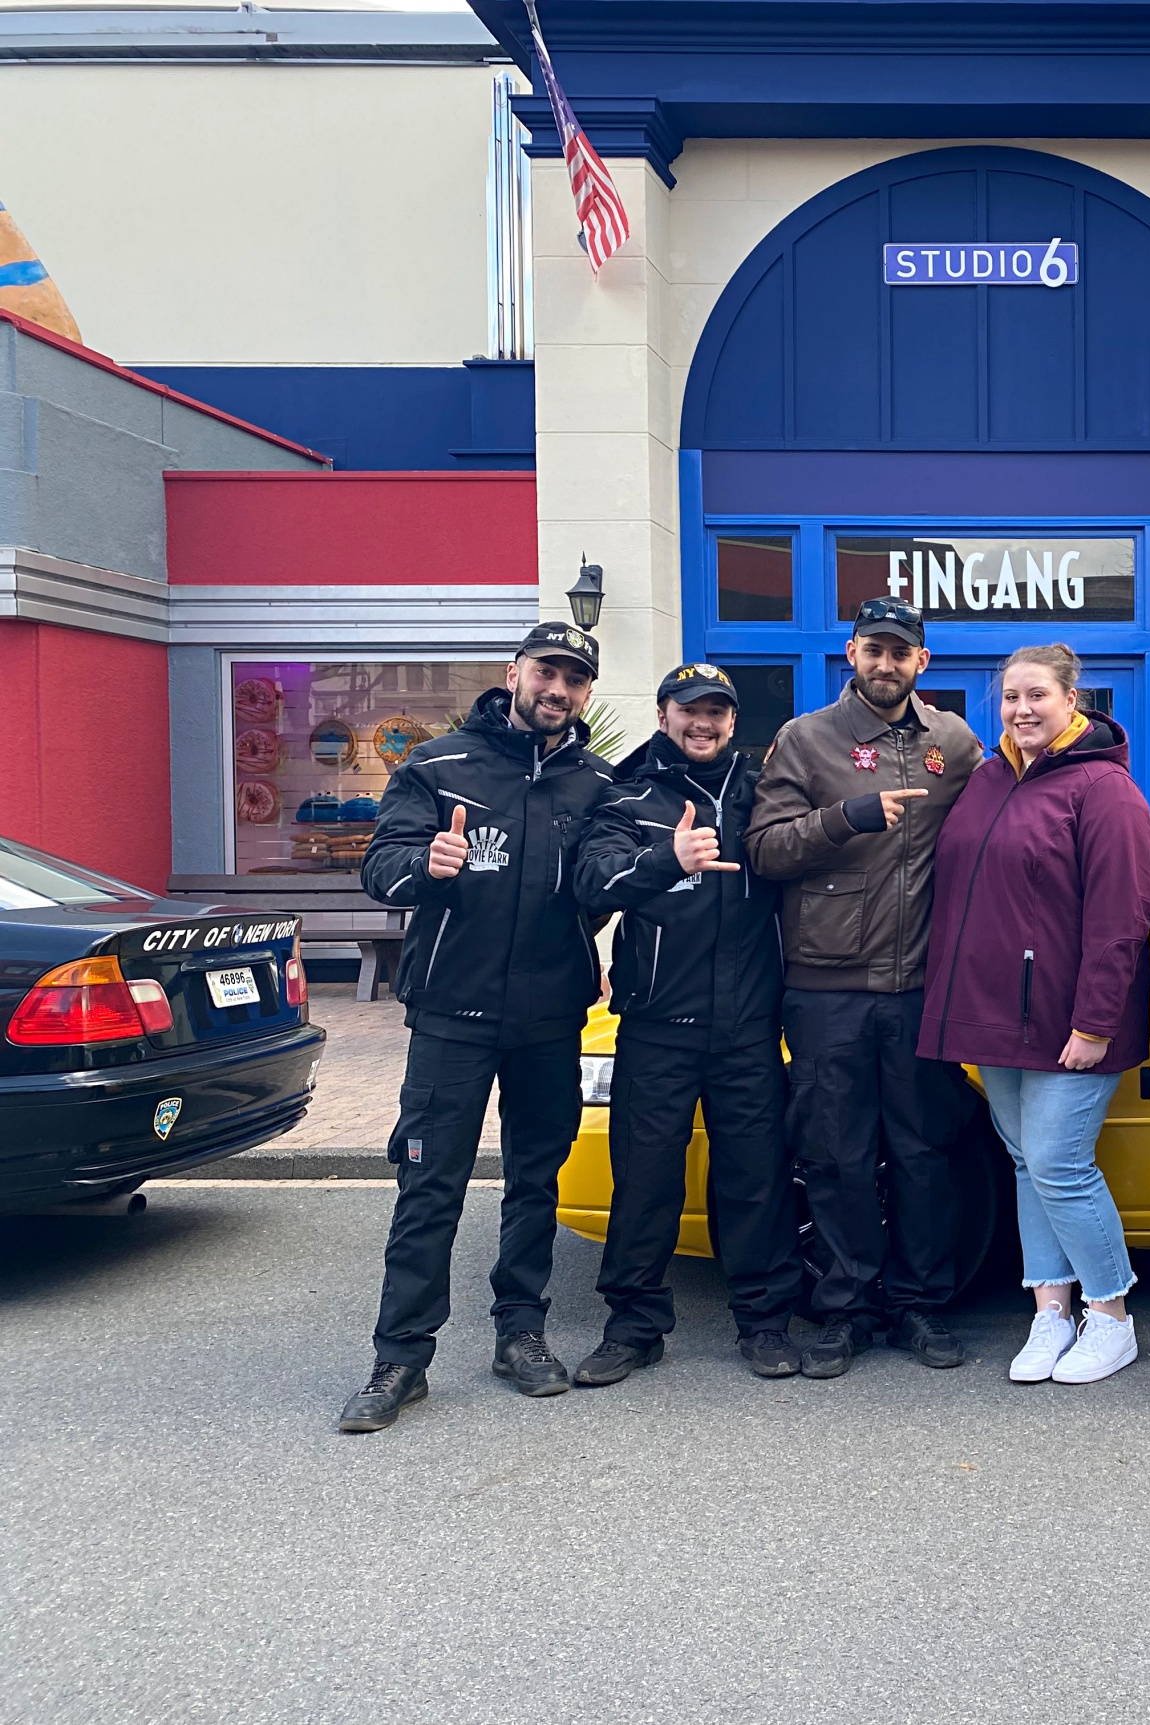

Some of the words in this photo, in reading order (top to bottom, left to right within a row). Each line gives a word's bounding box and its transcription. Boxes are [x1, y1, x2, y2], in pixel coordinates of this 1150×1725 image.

[896, 250, 1033, 278] STUDIO
[1039, 237, 1068, 288] 6
[886, 549, 1086, 611] EINGANG
[546, 633, 565, 641] NY
[677, 668, 696, 682] NY
[466, 848, 486, 863] OVIE
[487, 850, 508, 865] PARK
[143, 928, 200, 951] CITY
[203, 926, 232, 948] OF
[243, 923, 276, 944] NEW
[272, 918, 300, 941] YORK
[219, 971, 246, 986] 46896
[223, 986, 248, 998] POLICE
[160, 1100, 180, 1111] POLICE
